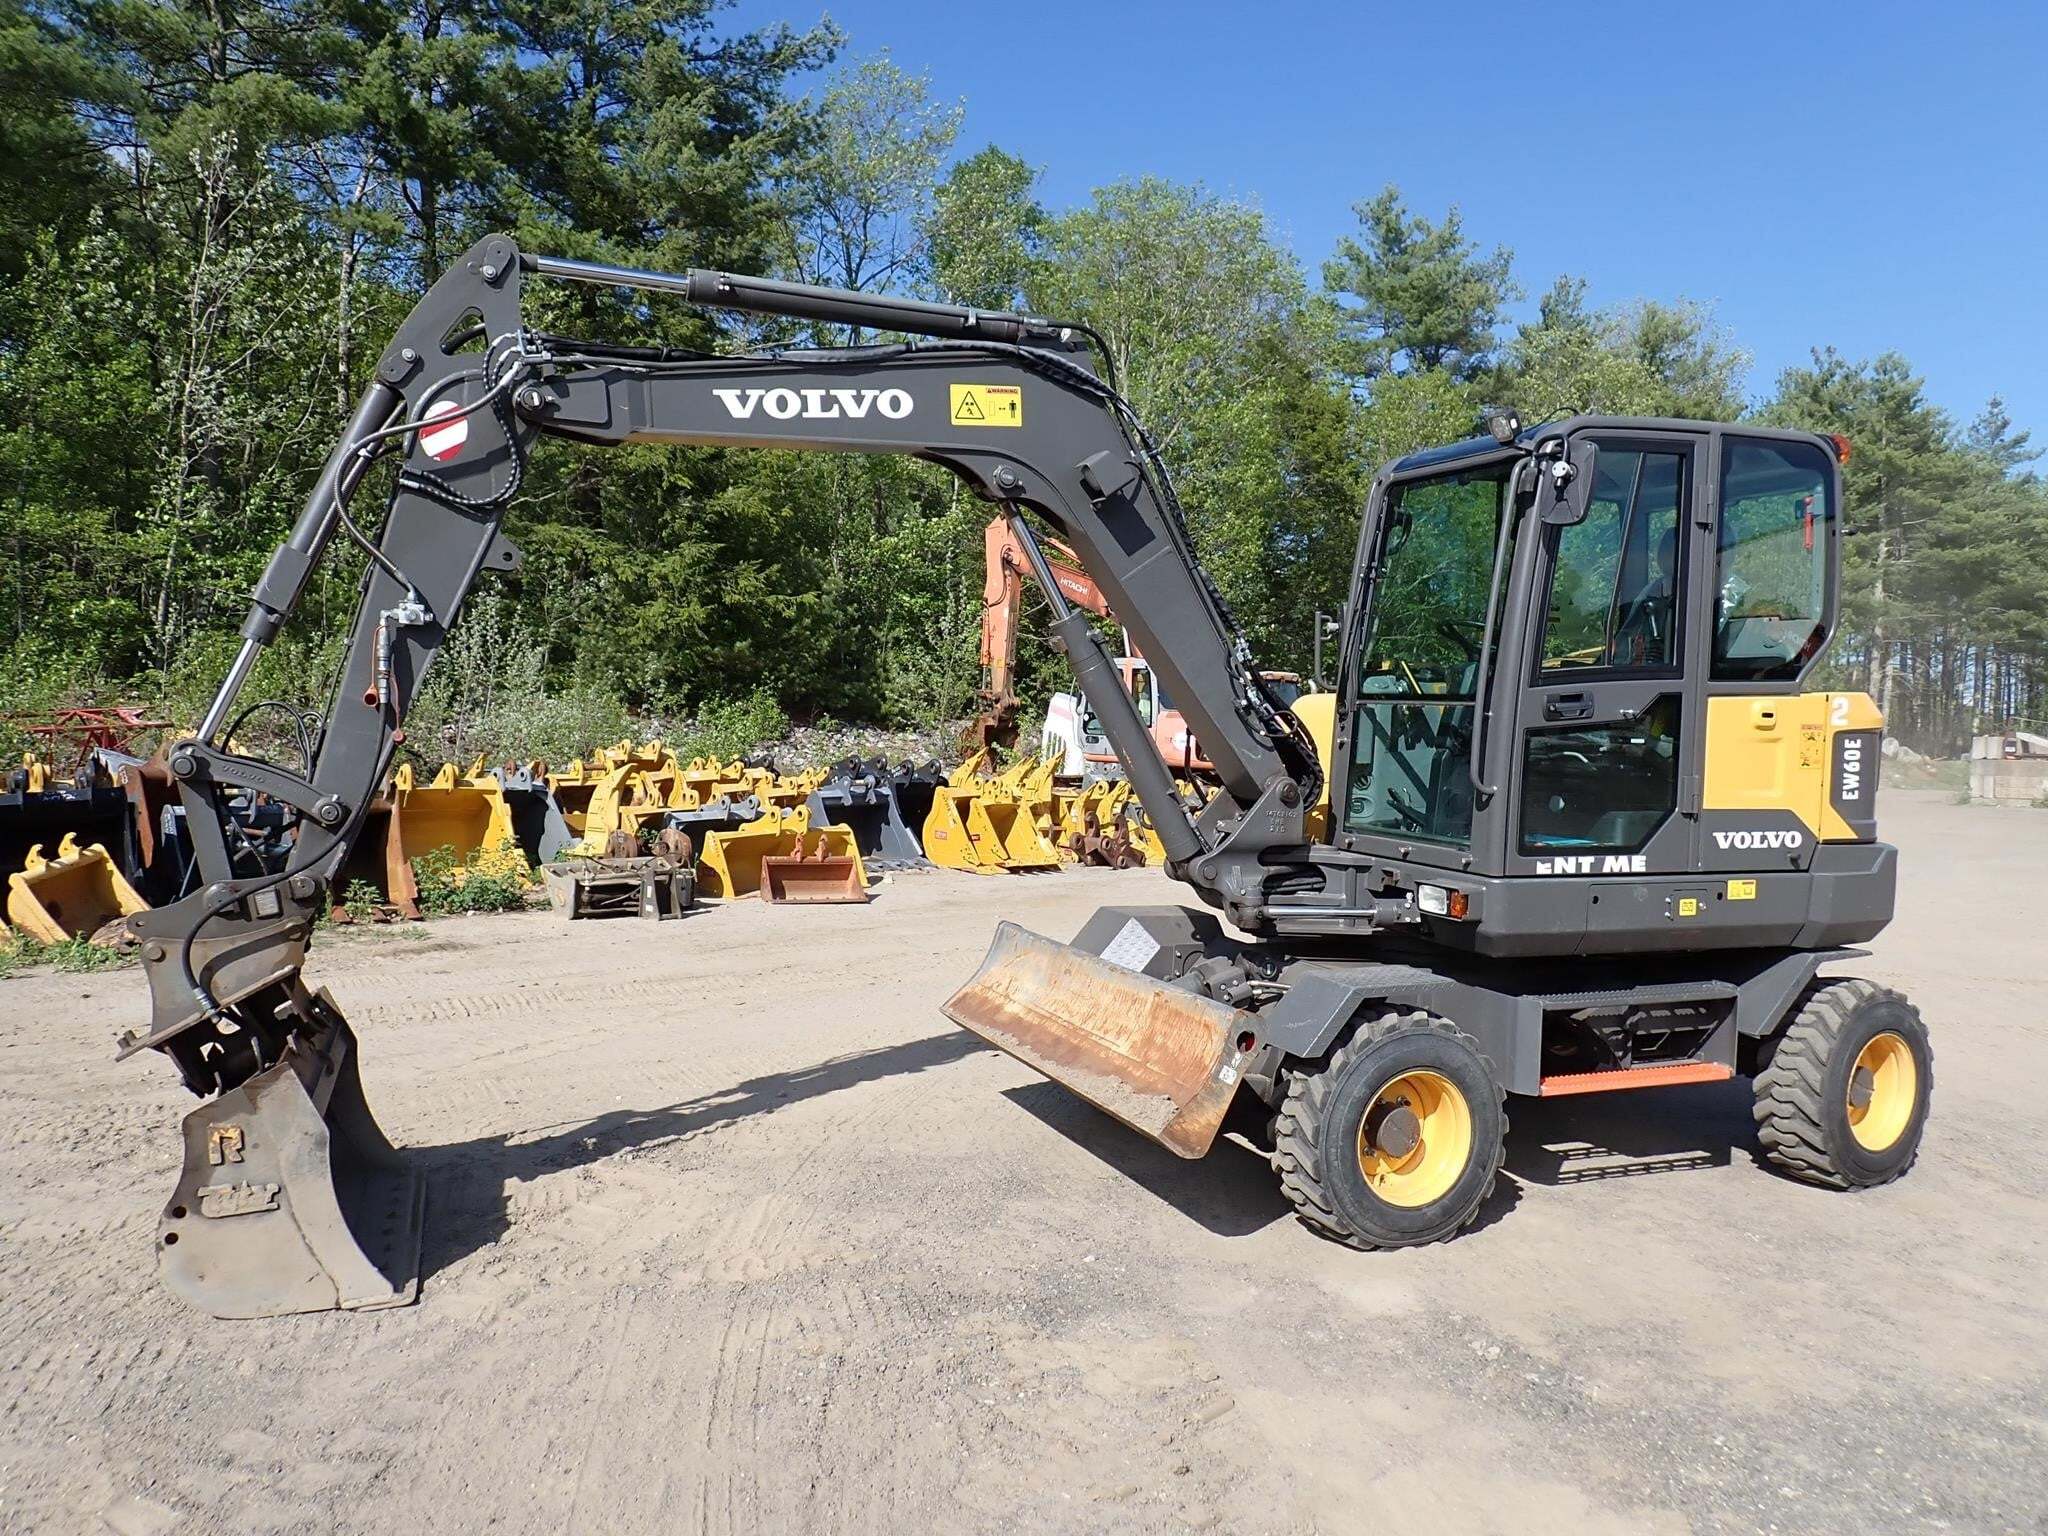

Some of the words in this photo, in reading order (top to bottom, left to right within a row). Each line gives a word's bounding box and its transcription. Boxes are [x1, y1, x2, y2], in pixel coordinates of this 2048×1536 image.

[712, 388, 914, 420] VOLVO
[1060, 577, 1088, 595] HITACHI
[1830, 696, 1849, 726] 2
[1842, 738, 1862, 801] EW60E
[1712, 830, 1803, 850] VOLVO
[1602, 855, 1647, 873] ME
